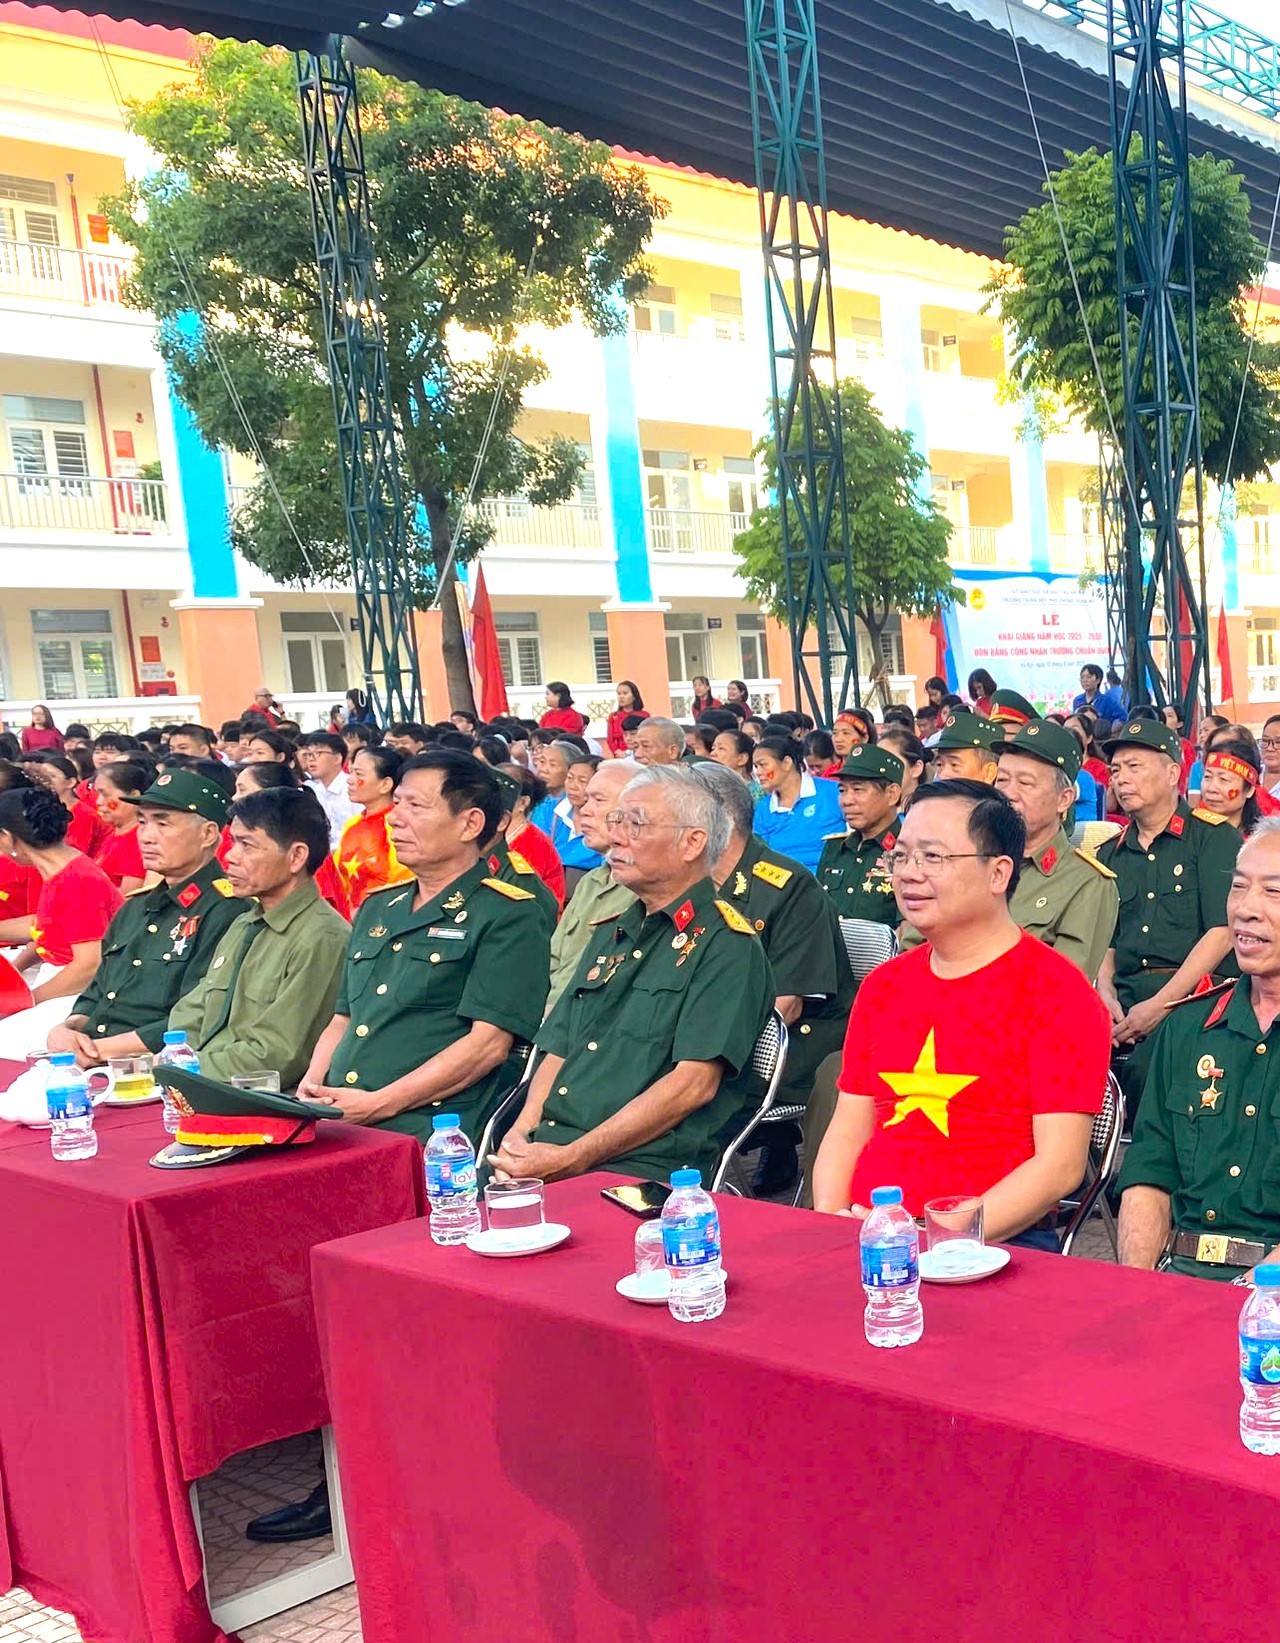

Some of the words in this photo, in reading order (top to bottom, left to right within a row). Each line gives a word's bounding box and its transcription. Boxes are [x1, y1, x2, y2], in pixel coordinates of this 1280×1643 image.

[998, 632, 1013, 641] KHAI
[1220, 757, 1235, 769] VIỆT
[1235, 763, 1250, 777] NAM
[454, 1170, 475, 1184] laV
